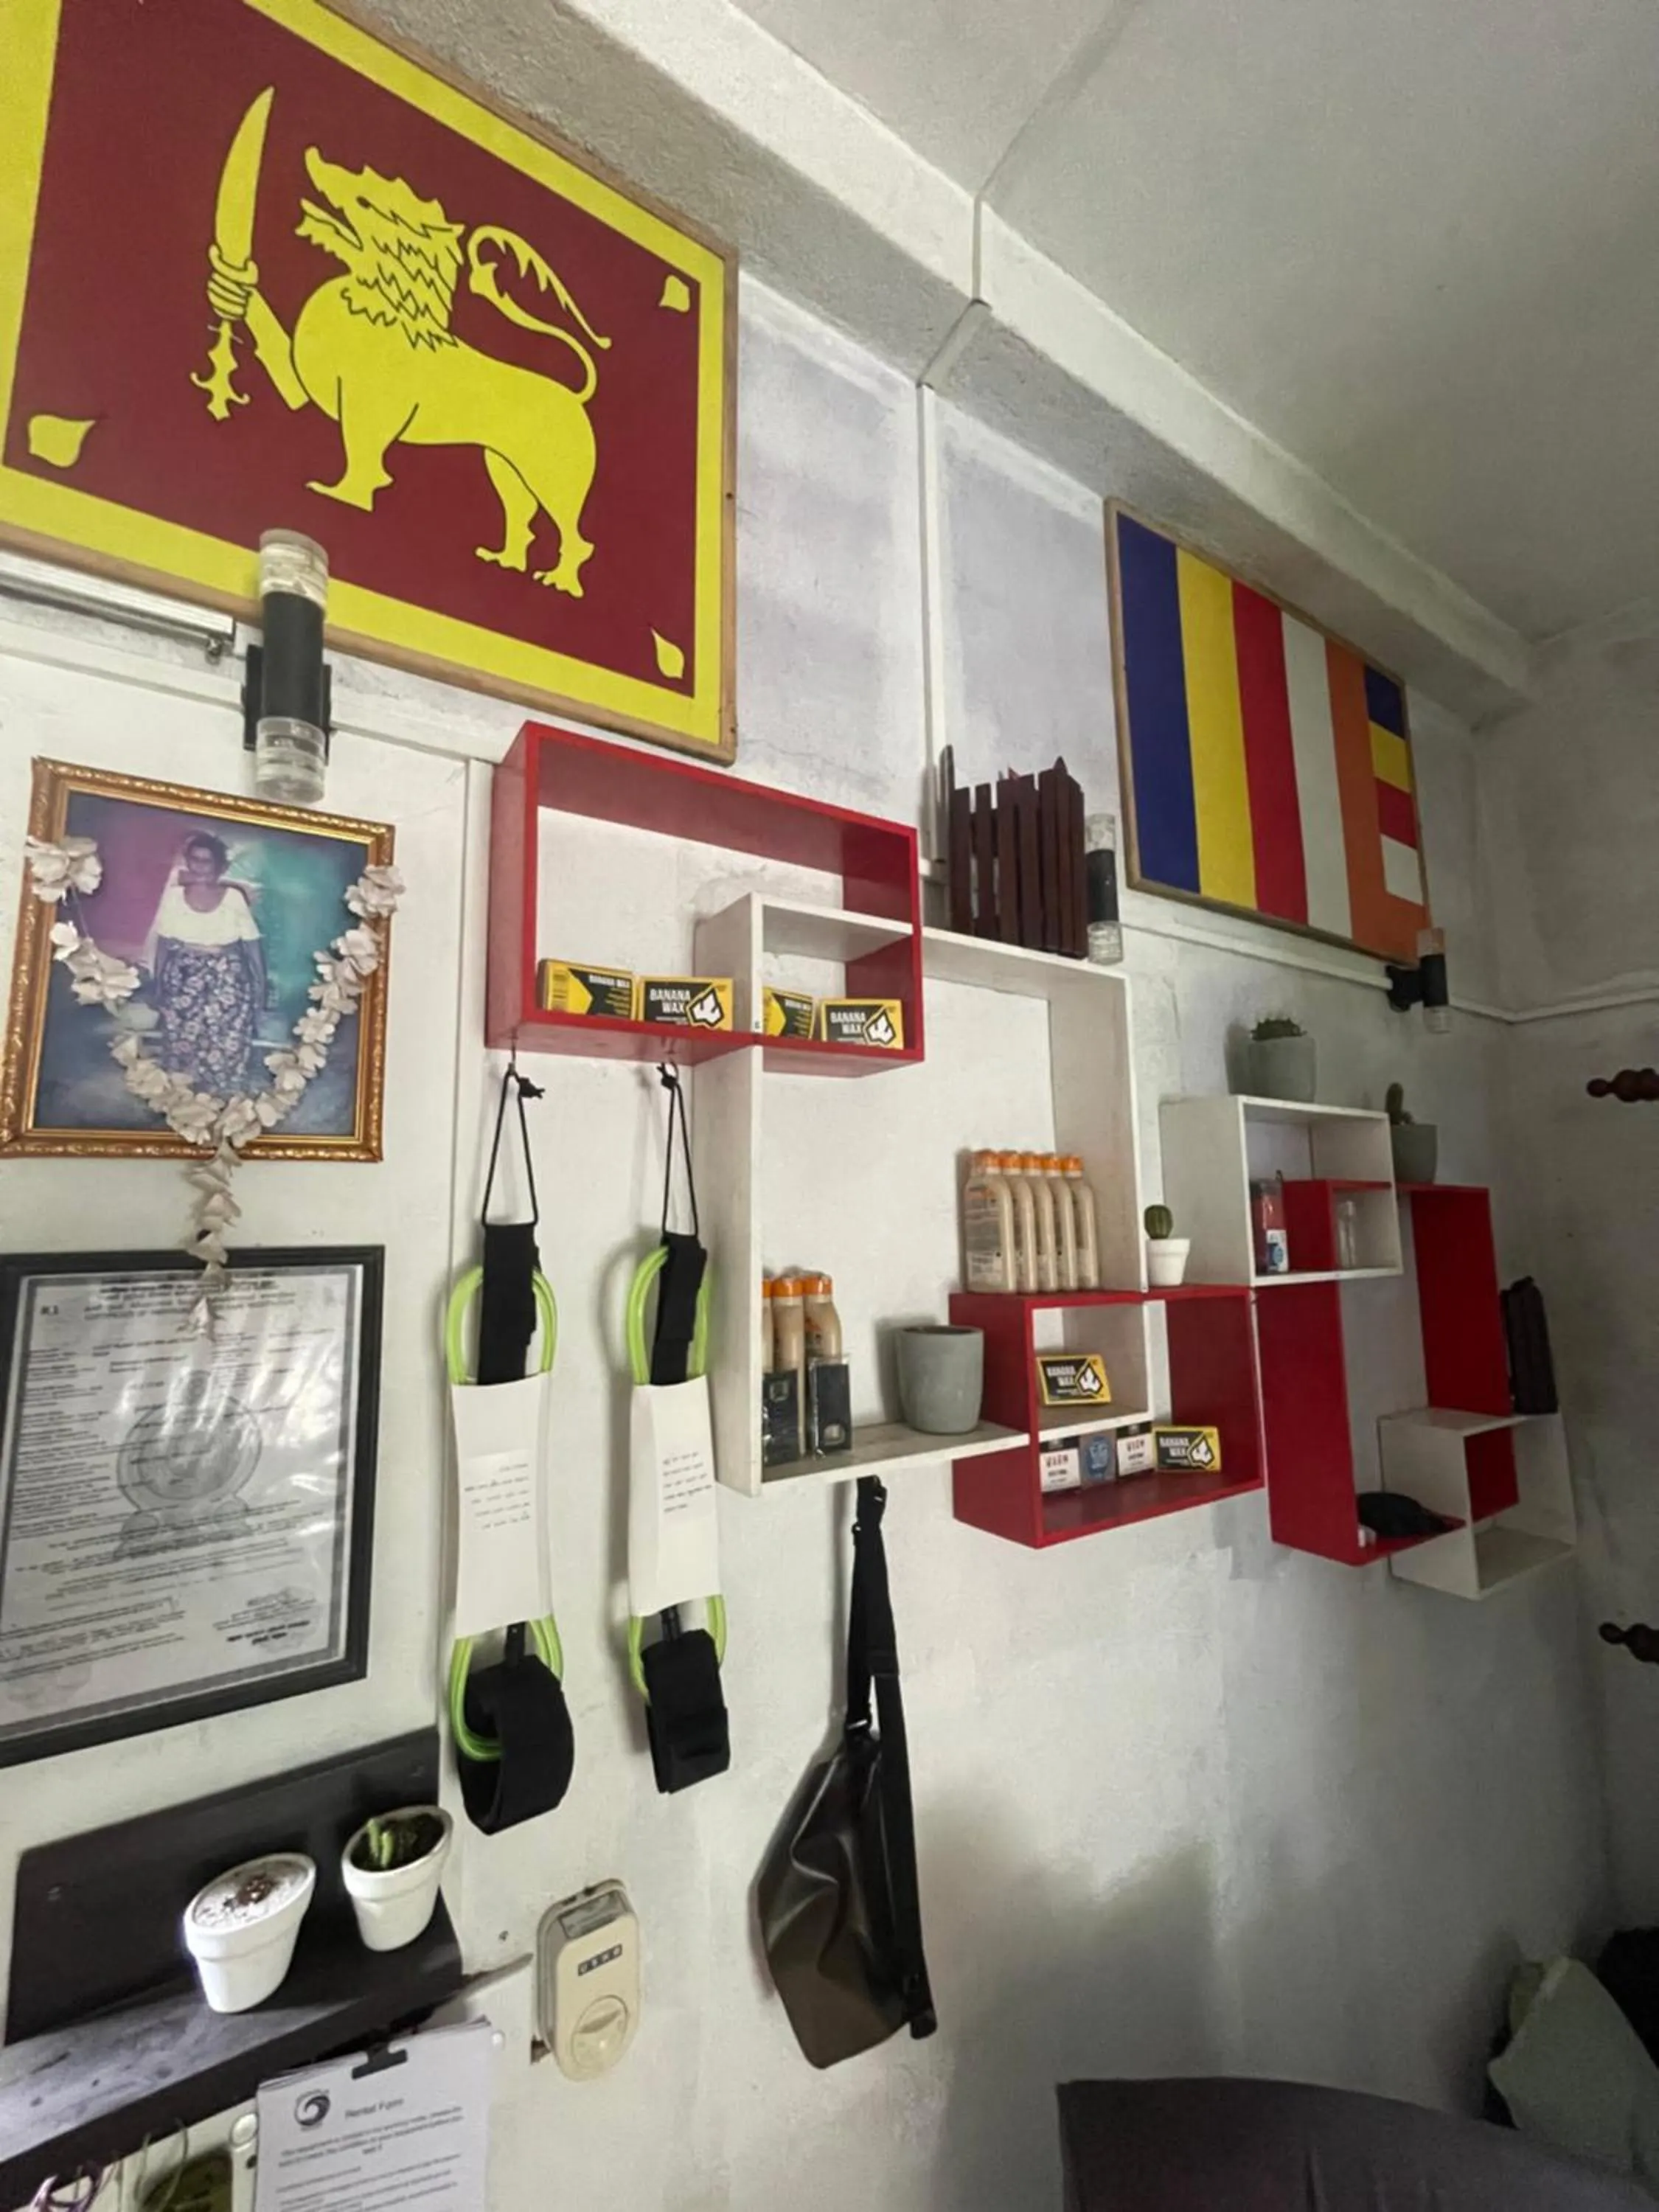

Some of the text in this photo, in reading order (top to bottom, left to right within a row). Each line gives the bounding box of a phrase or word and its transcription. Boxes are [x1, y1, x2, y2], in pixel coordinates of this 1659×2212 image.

[650, 988, 691, 1001] BANANA
[662, 1001, 686, 1014] WAX
[830, 1012, 866, 1023] BANANA
[842, 1023, 862, 1034] WAX
